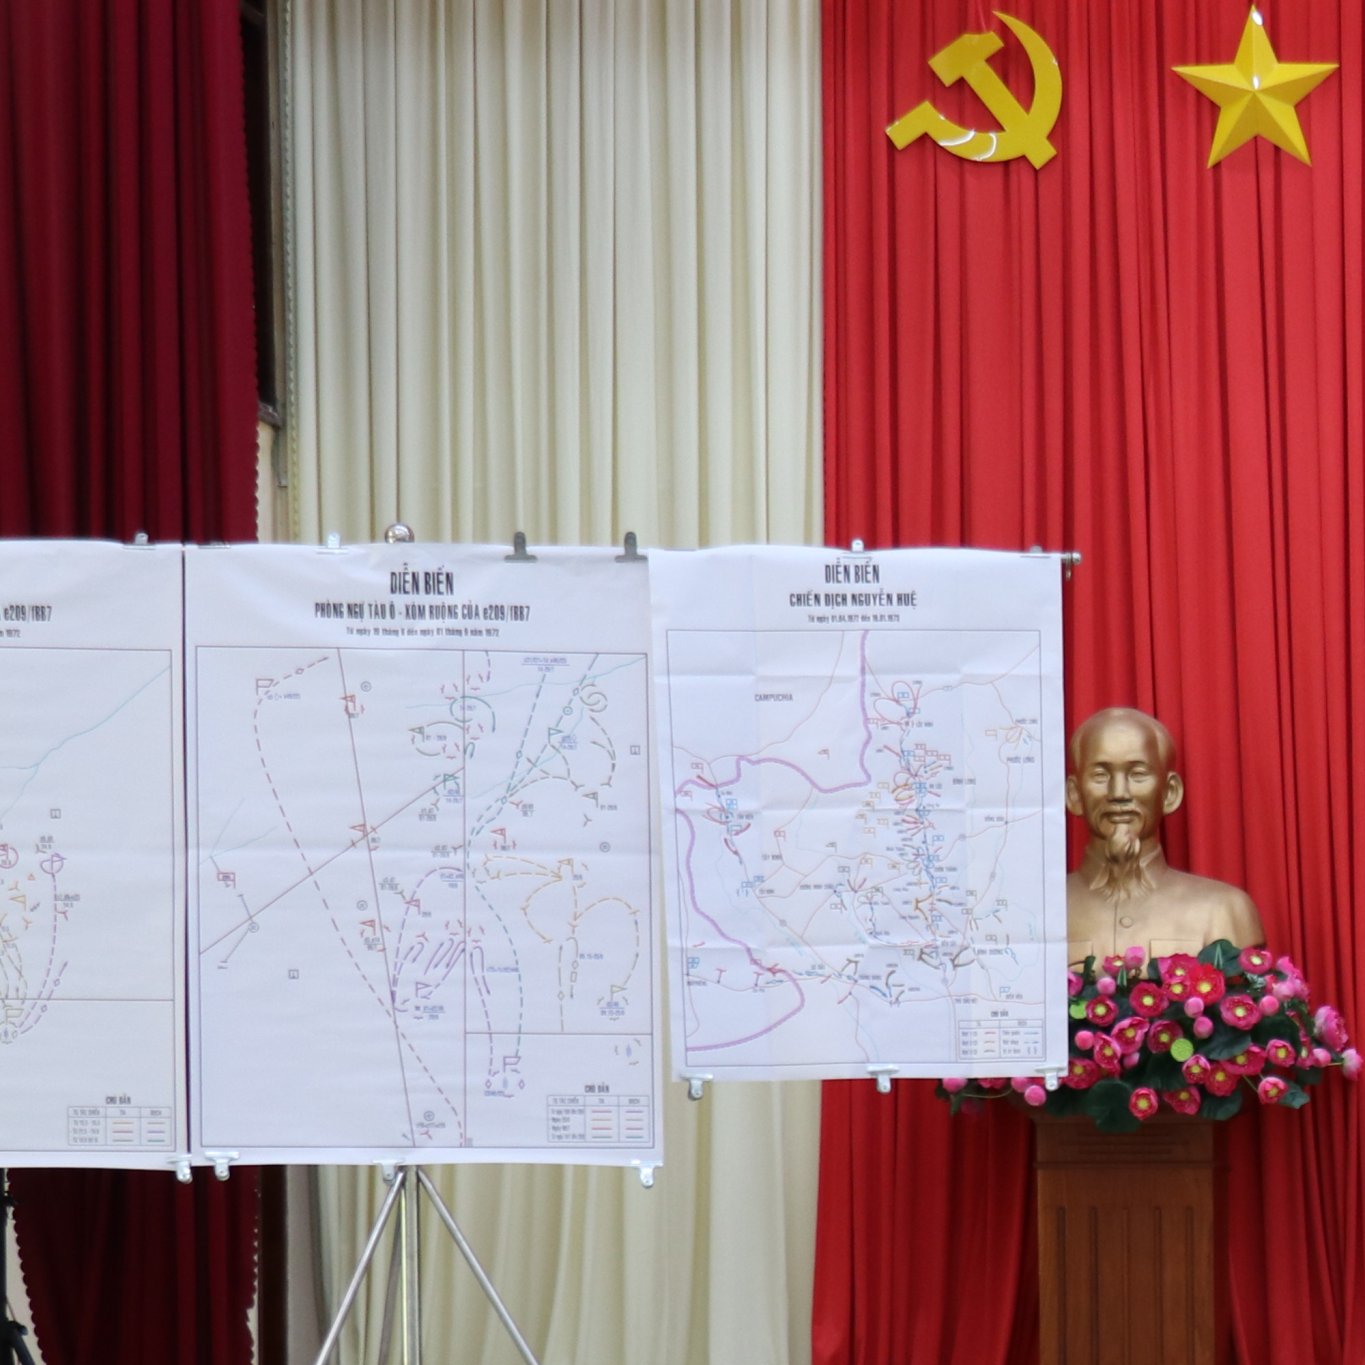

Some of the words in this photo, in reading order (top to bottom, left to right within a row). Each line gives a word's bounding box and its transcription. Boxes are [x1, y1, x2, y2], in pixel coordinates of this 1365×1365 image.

[390, 563, 420, 595] DIỄN
[424, 565, 454, 595] BIẾN
[854, 558, 880, 584] BIẾN
[789, 590, 821, 607] CHIẾN
[824, 593, 848, 609] DỊCH
[851, 589, 893, 607] NGUYỄN
[896, 590, 917, 609] HUỆ
[314, 600, 344, 620] PHÒNG
[368, 601, 387, 620] TÀU
[405, 601, 426, 620] XÓM
[429, 602, 459, 623] RUỘNG
[461, 600, 480, 620] CỦA
